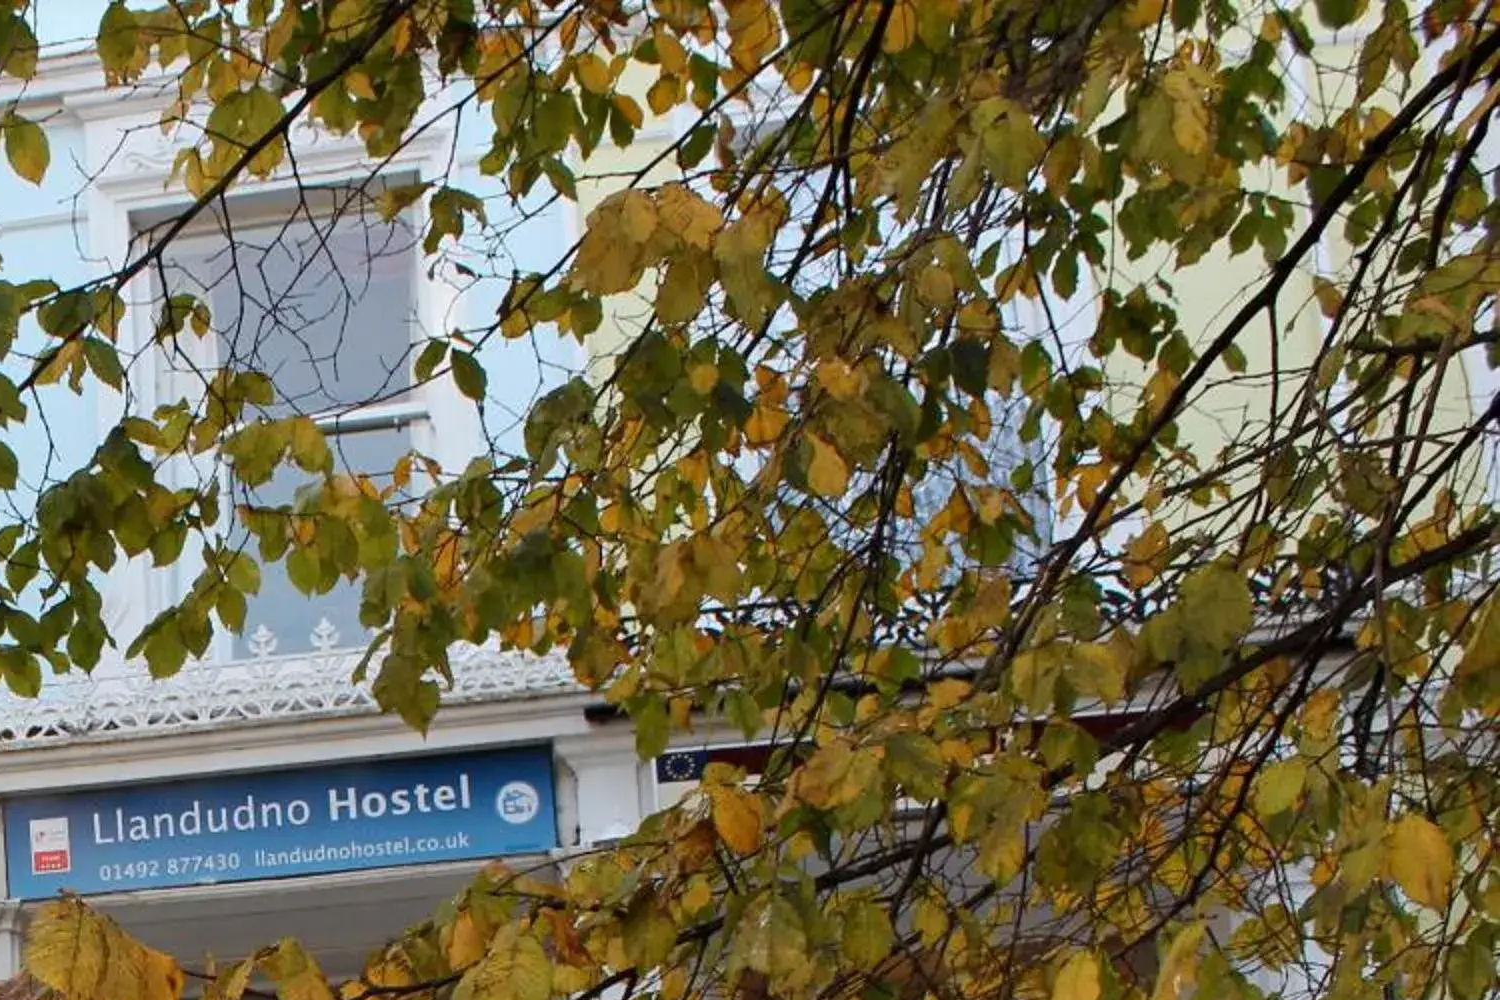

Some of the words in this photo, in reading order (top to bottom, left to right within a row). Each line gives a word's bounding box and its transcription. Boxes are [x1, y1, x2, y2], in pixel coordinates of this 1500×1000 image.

[93, 795, 310, 844] Llandudno
[328, 773, 470, 821] Hostel
[100, 860, 159, 881] 01492
[167, 853, 240, 875] 877430
[255, 832, 469, 867] llandudnohostel.co.uk
